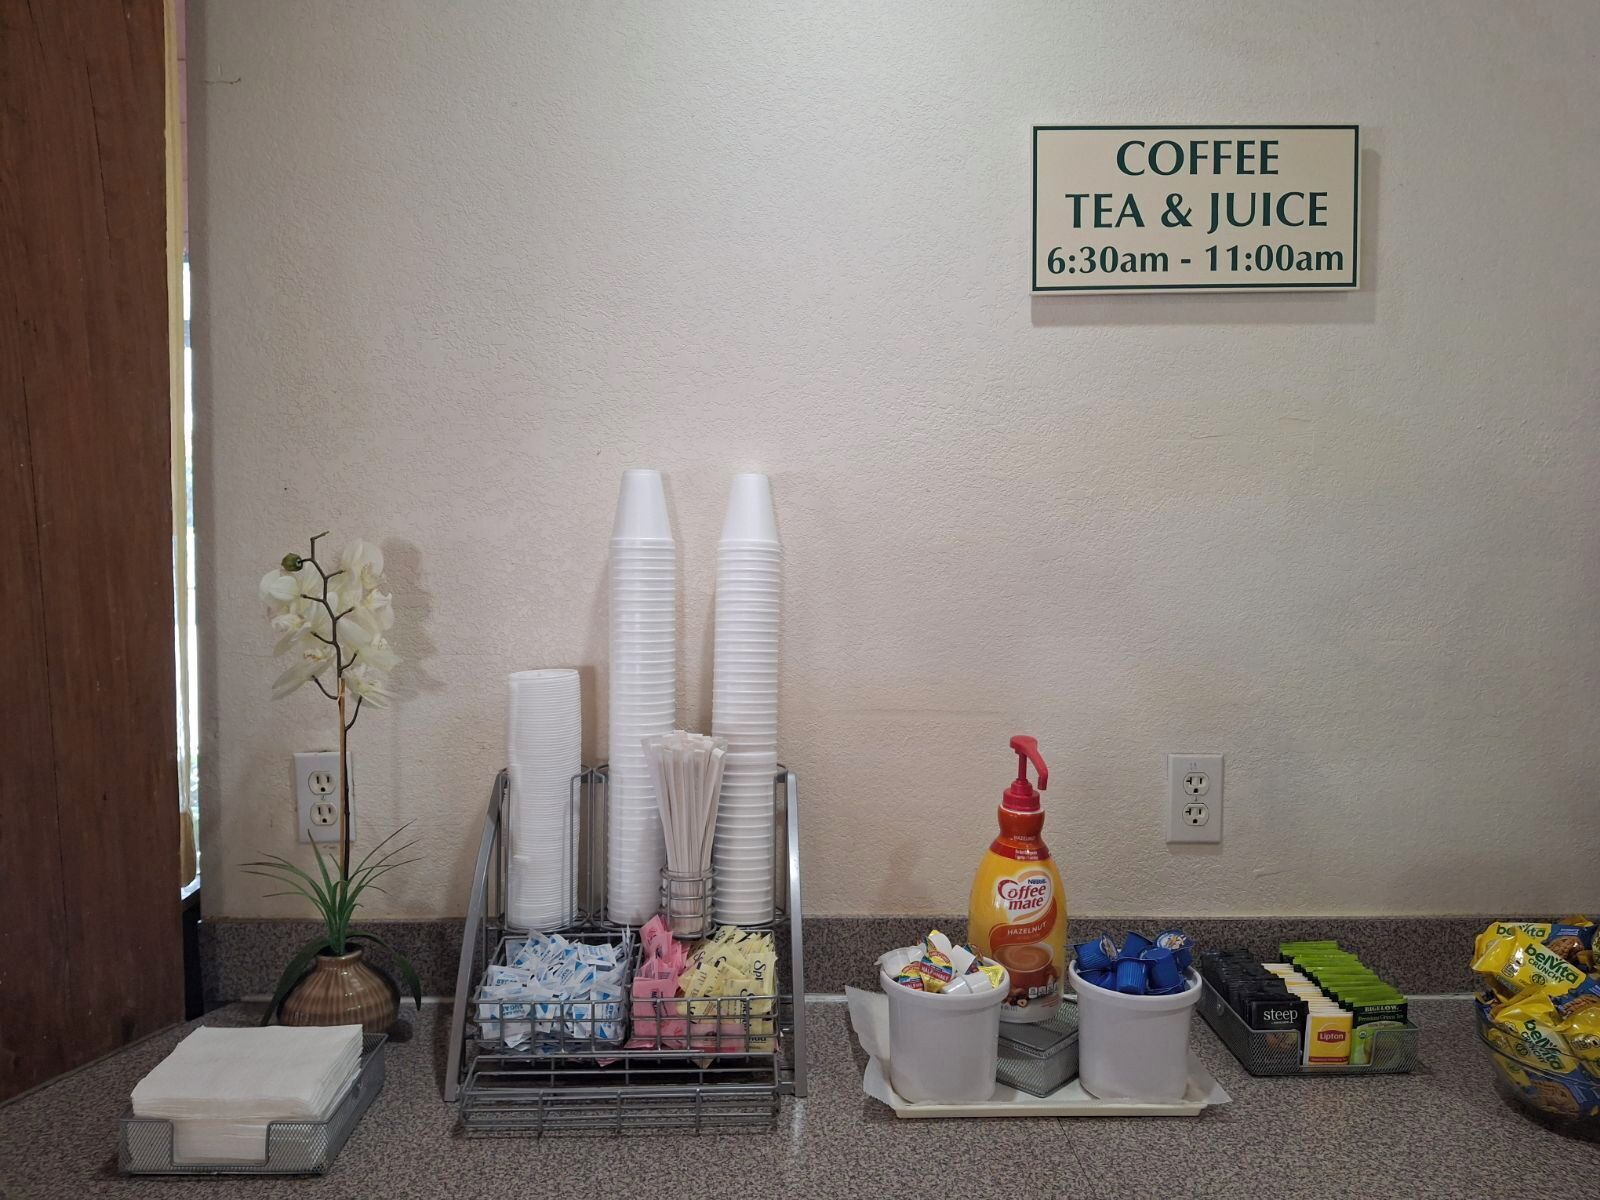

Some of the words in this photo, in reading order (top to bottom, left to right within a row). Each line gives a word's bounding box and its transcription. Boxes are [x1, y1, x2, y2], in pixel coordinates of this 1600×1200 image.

[1116, 140, 1279, 176] COFFEE
[1065, 193, 1145, 228] TEA
[1161, 193, 1192, 227] &
[1207, 191, 1328, 235] JUICE
[1047, 246, 1169, 274] 6:30am
[1205, 244, 1344, 272] 11:00am
[998, 879, 1047, 901] Coffee
[1008, 897, 1044, 911] mate
[1007, 921, 1047, 936] HAZELNUT
[1524, 943, 1579, 985] belVita
[1528, 958, 1565, 984] CRUNCHY
[1263, 1008, 1298, 1024] steep
[1319, 1032, 1345, 1041] Lipton
